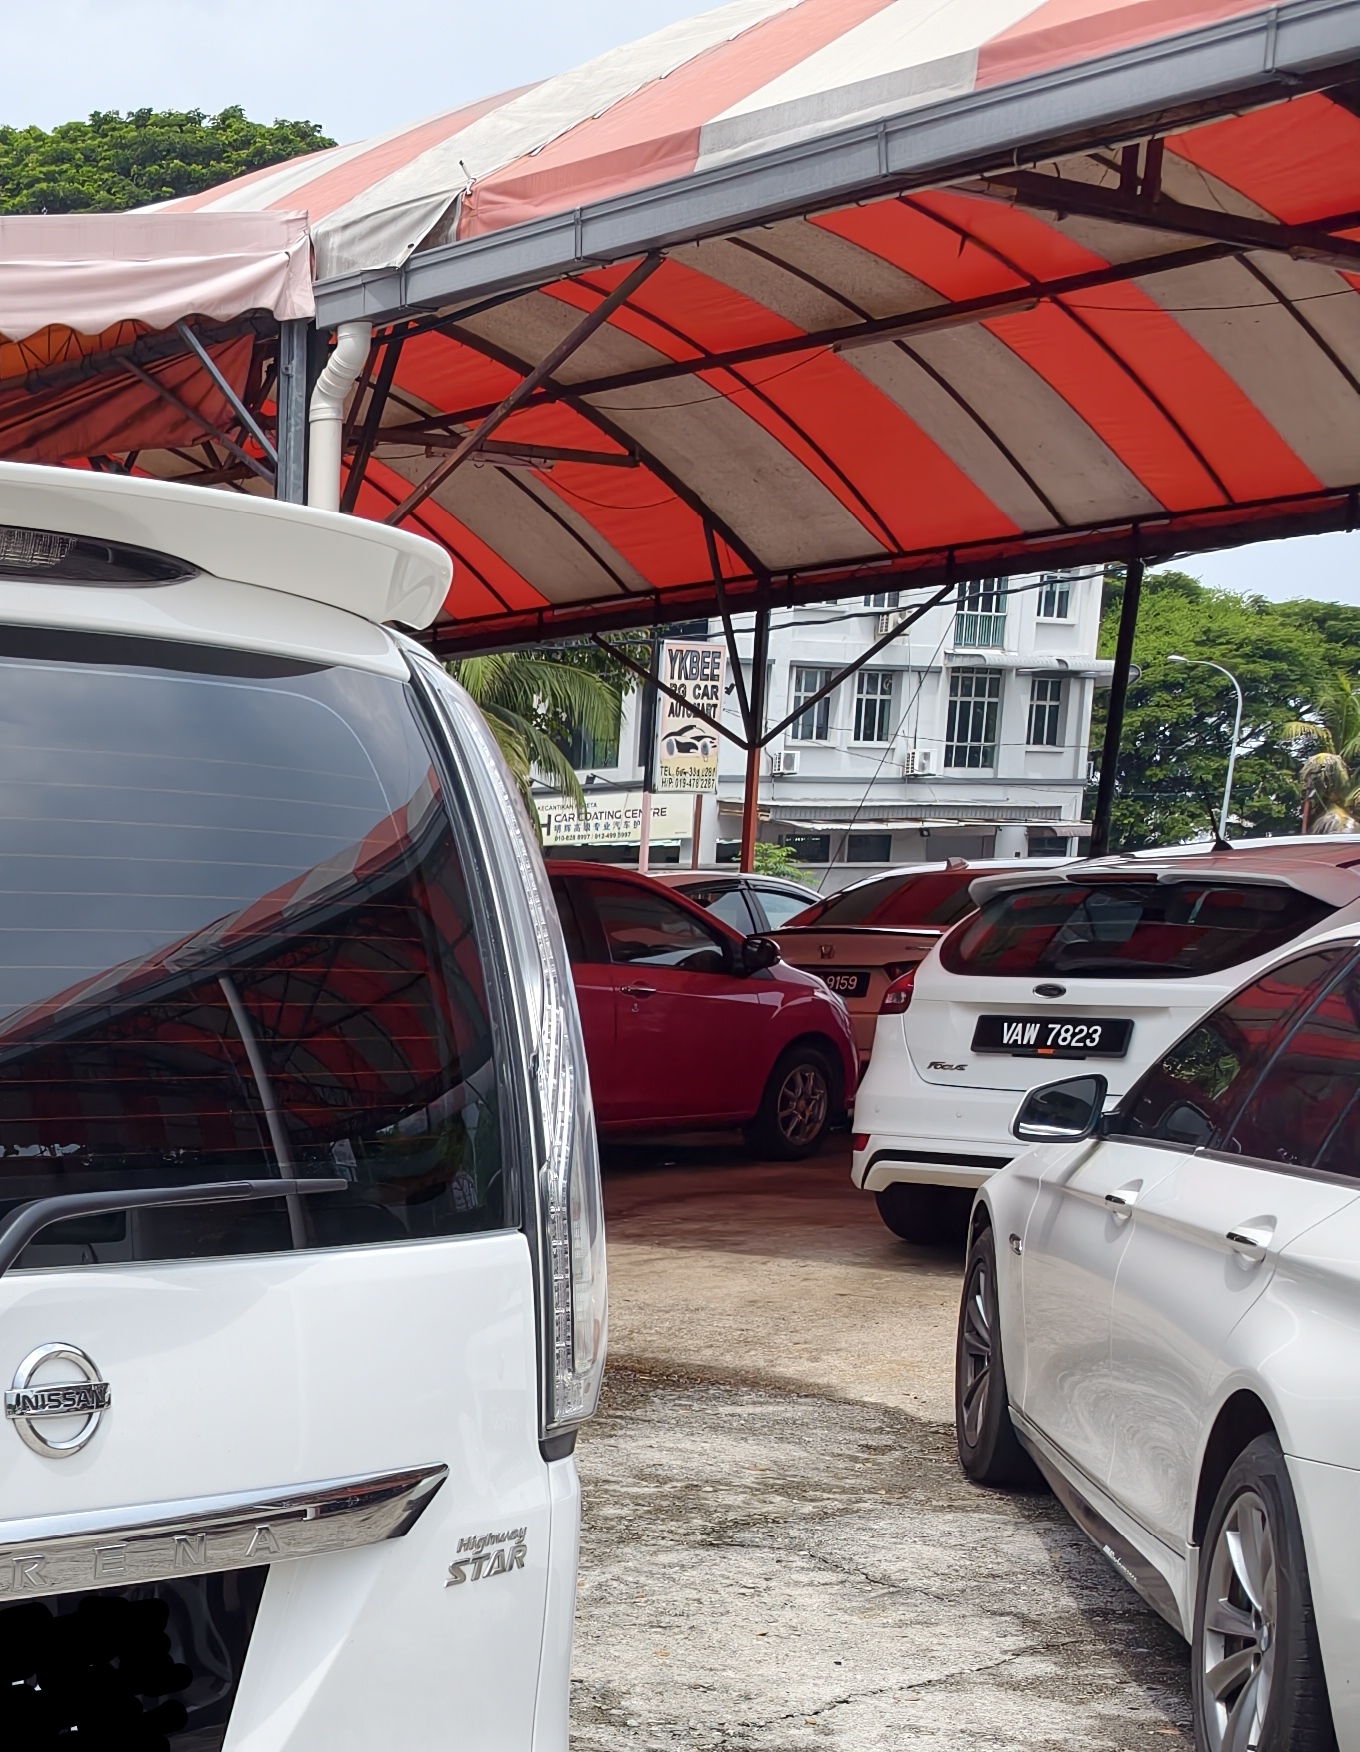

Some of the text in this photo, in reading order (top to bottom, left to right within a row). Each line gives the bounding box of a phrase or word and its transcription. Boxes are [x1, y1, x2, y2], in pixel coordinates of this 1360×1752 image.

[692, 683, 719, 700] CAR
[554, 807, 667, 823] CAR COATING CENRE
[827, 975, 857, 990] 9159
[1002, 1022, 1102, 1048] VAW 7823
[15, 1383, 110, 1412] NISSAN
[456, 1526, 528, 1555] Highway
[443, 1544, 528, 1588] STAR
